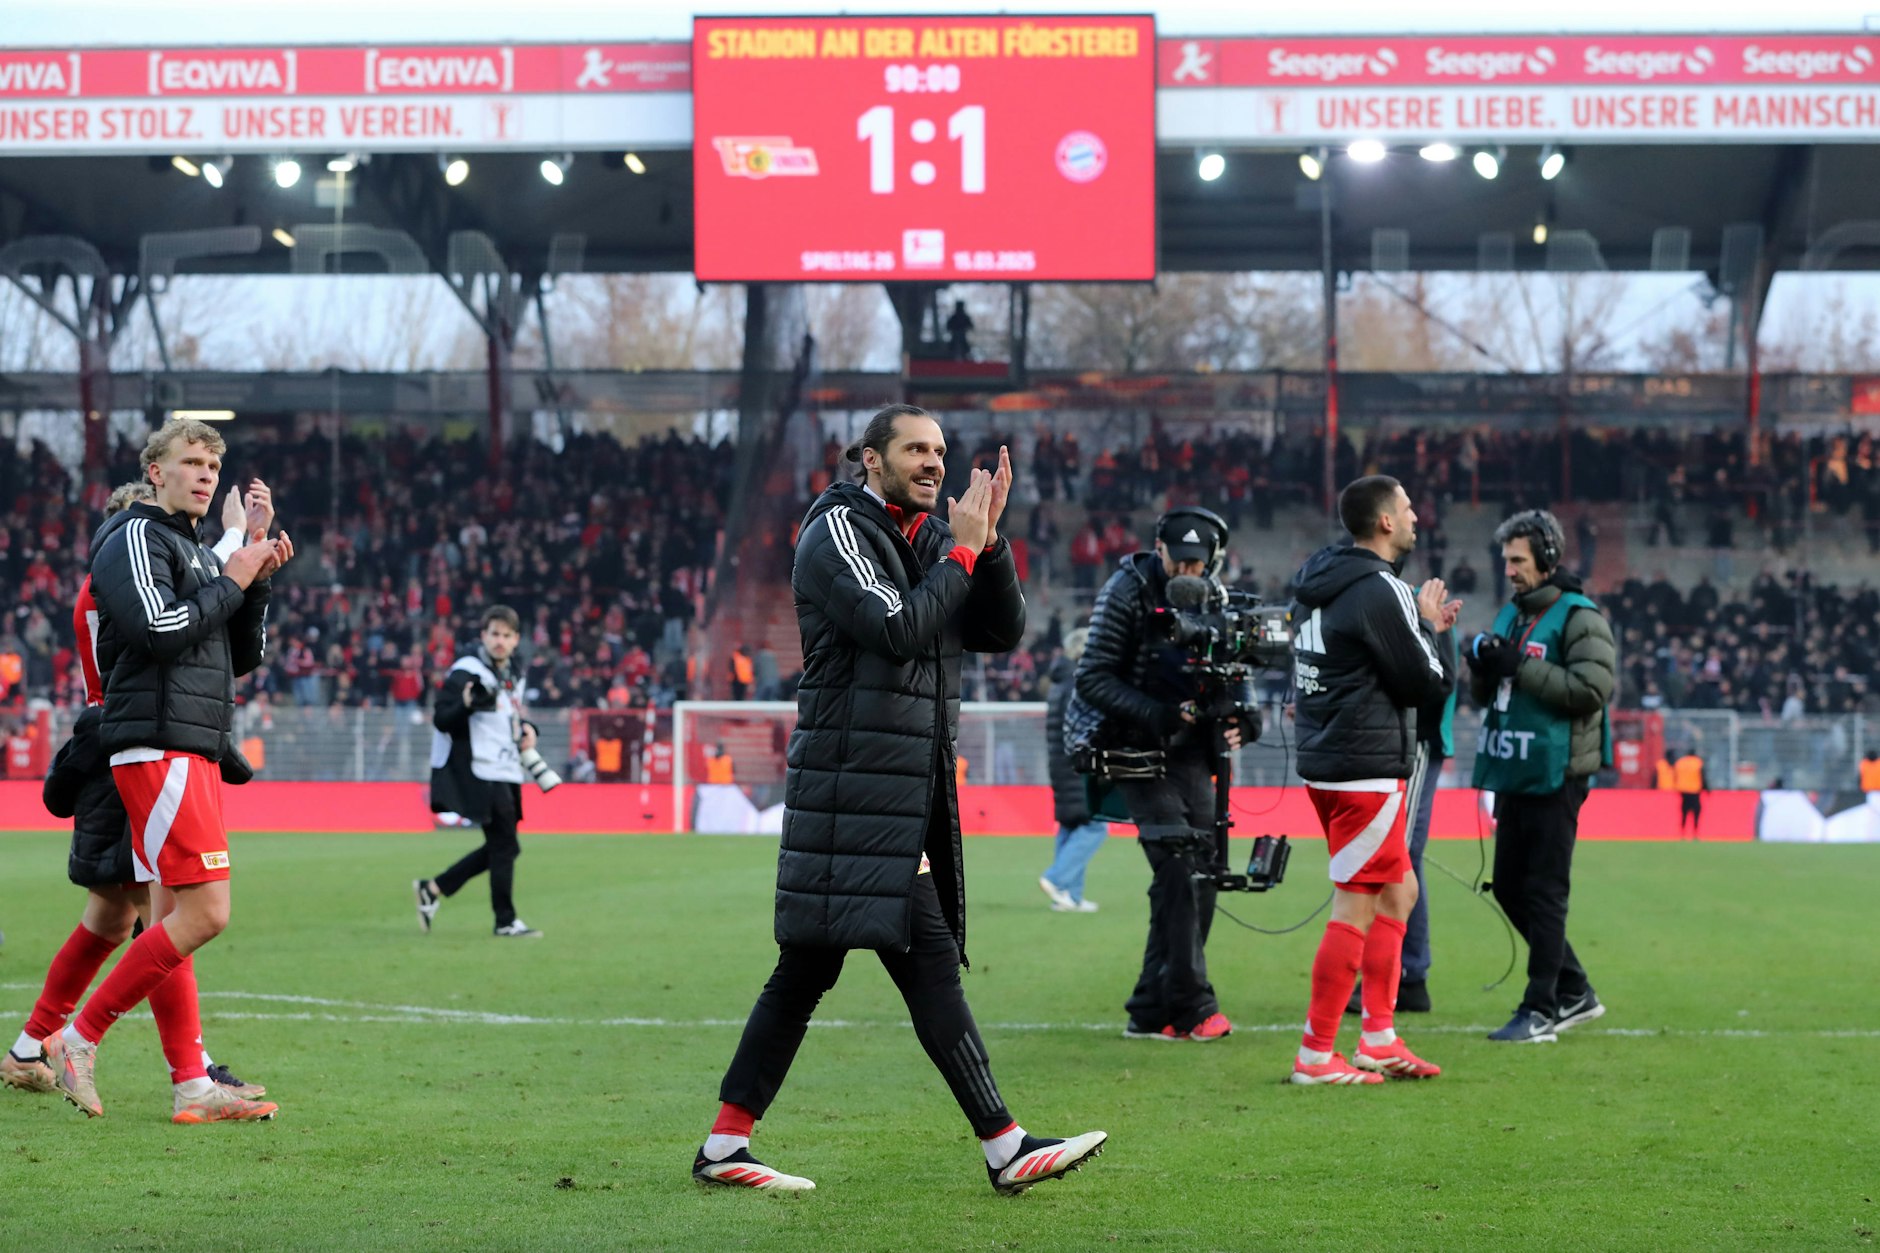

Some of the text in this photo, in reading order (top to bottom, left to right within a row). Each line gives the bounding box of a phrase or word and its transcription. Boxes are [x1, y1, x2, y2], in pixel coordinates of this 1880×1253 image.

[708, 21, 1138, 59] STADION AN DER ALTEN FÖRSTEREI
[884, 64, 960, 93] 90:00
[1268, 47, 1366, 81] Seeger
[1425, 46, 1525, 80] Seeger
[1584, 45, 1683, 79] Seeger
[1743, 45, 1841, 79] Seeger
[100, 107, 203, 139] STOLZ.
[223, 106, 327, 138] UNSER
[340, 105, 463, 138] VEREIN.
[1317, 95, 1880, 129] UNSERE LIEBE. UNSERE MANNSCH
[801, 250, 871, 271] SPIELTAG
